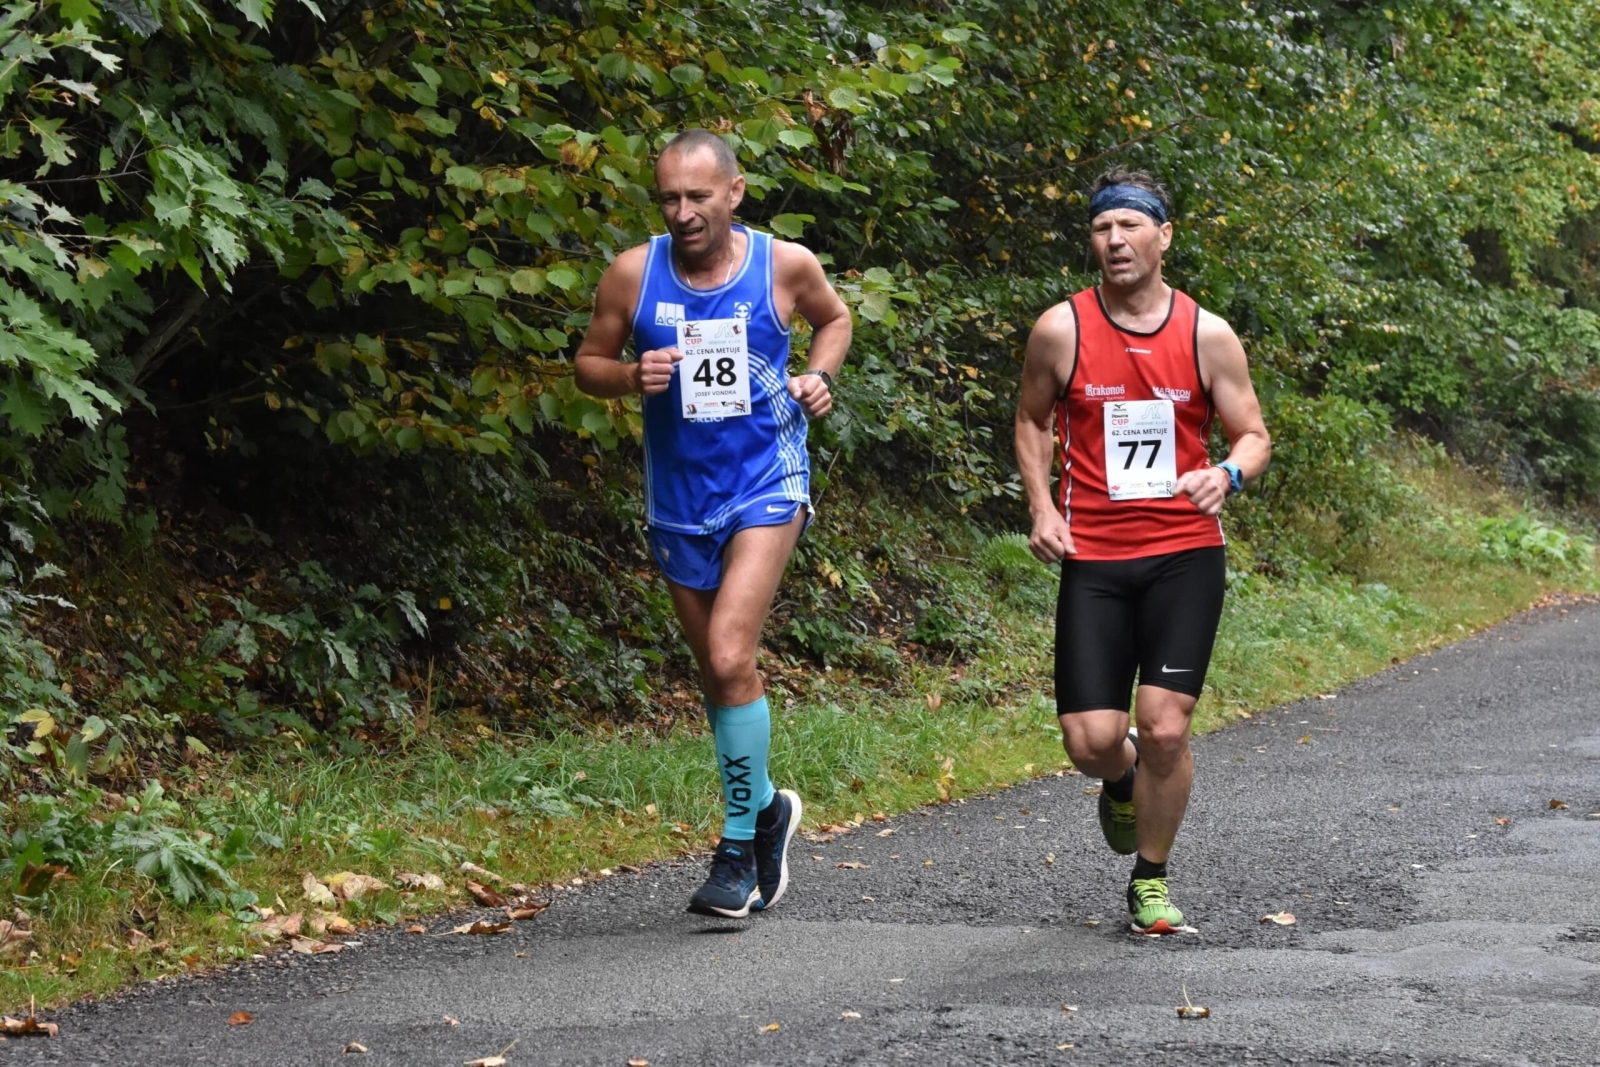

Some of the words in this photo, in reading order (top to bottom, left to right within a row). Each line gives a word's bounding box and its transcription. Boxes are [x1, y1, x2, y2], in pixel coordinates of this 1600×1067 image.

[685, 338, 702, 346] CUP
[716, 346, 741, 354] METUJE
[693, 357, 737, 387] 48
[1152, 386, 1191, 397] MARATON
[1118, 440, 1162, 470] 77
